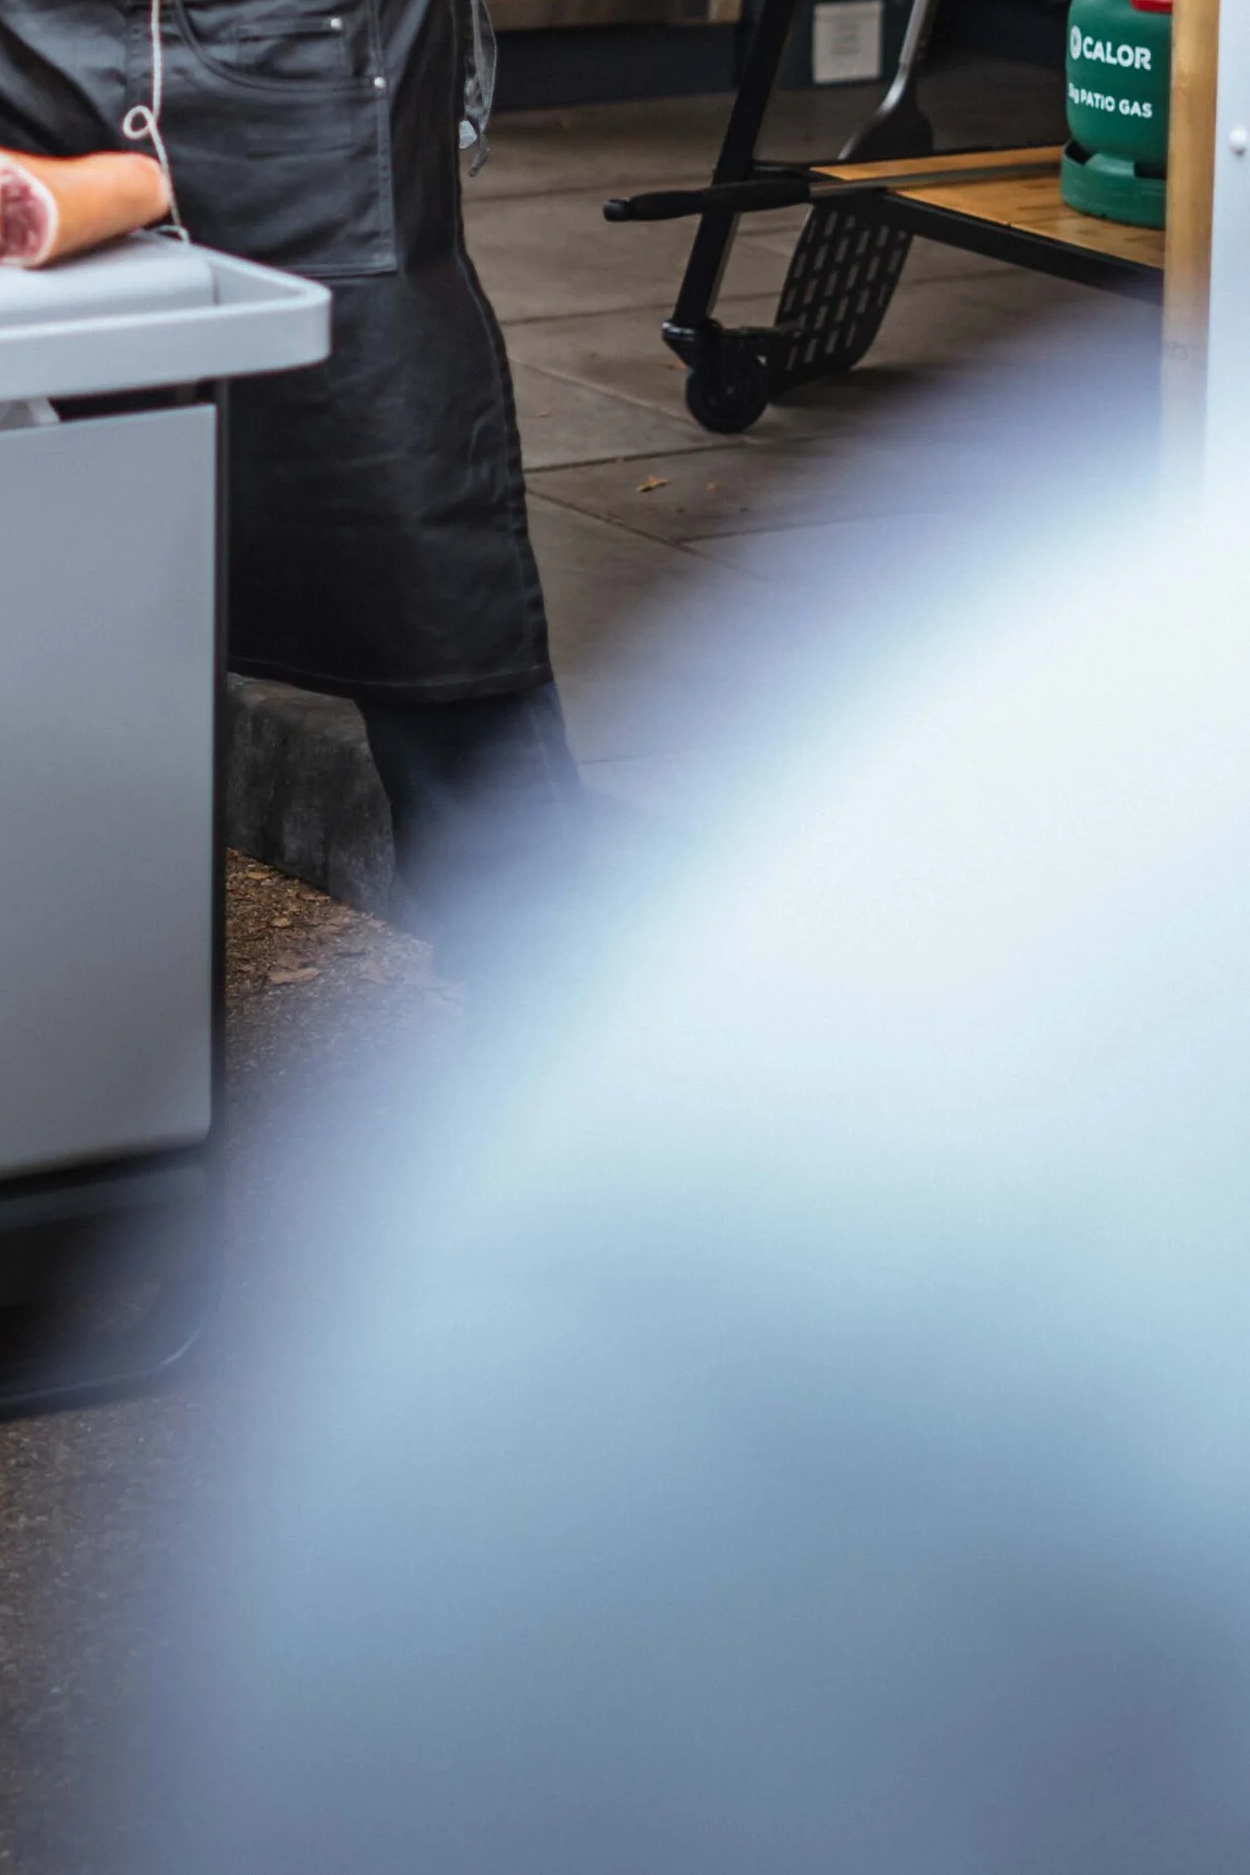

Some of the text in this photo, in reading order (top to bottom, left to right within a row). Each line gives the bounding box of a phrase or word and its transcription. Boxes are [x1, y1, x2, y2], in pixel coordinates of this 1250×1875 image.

[1082, 35, 1151, 71] CALOR
[1080, 88, 1115, 112] PATIO
[1118, 98, 1152, 118] GAS
